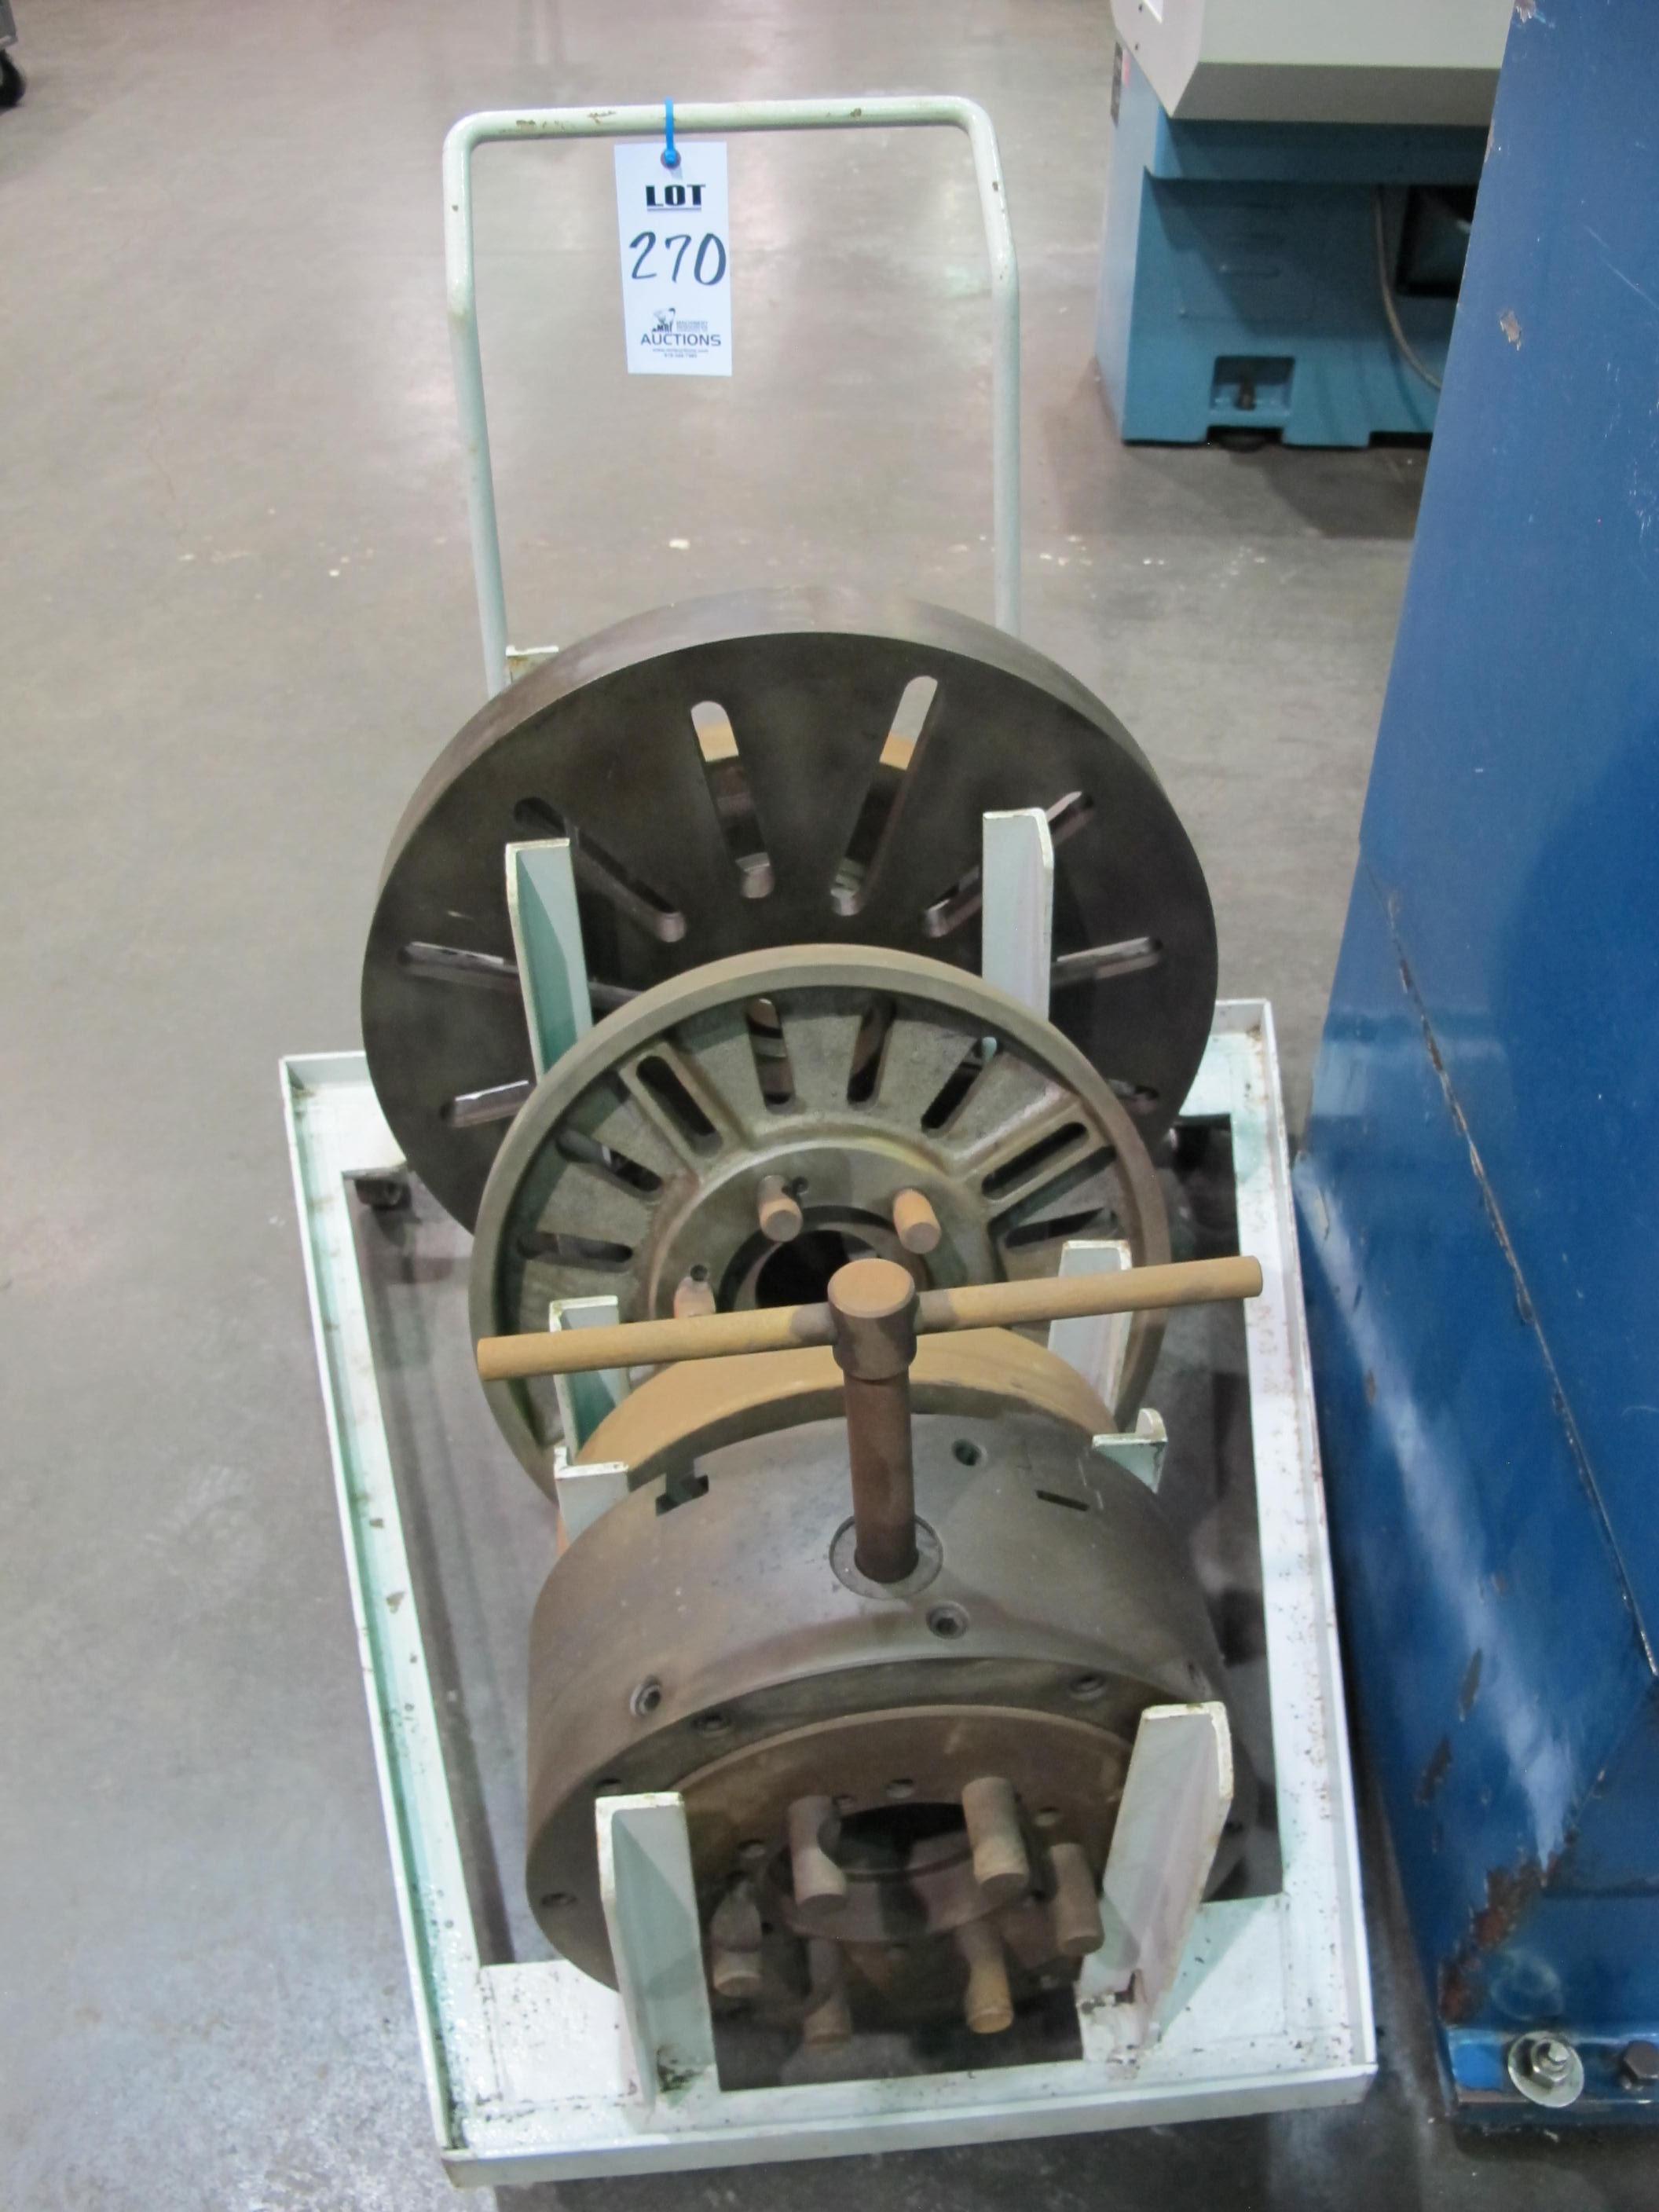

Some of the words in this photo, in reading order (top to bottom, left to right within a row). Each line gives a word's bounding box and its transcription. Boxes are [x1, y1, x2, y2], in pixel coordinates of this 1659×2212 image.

[645, 184, 705, 207] LOT
[628, 231, 727, 286] 270
[640, 333, 721, 346] AUCTIONS
